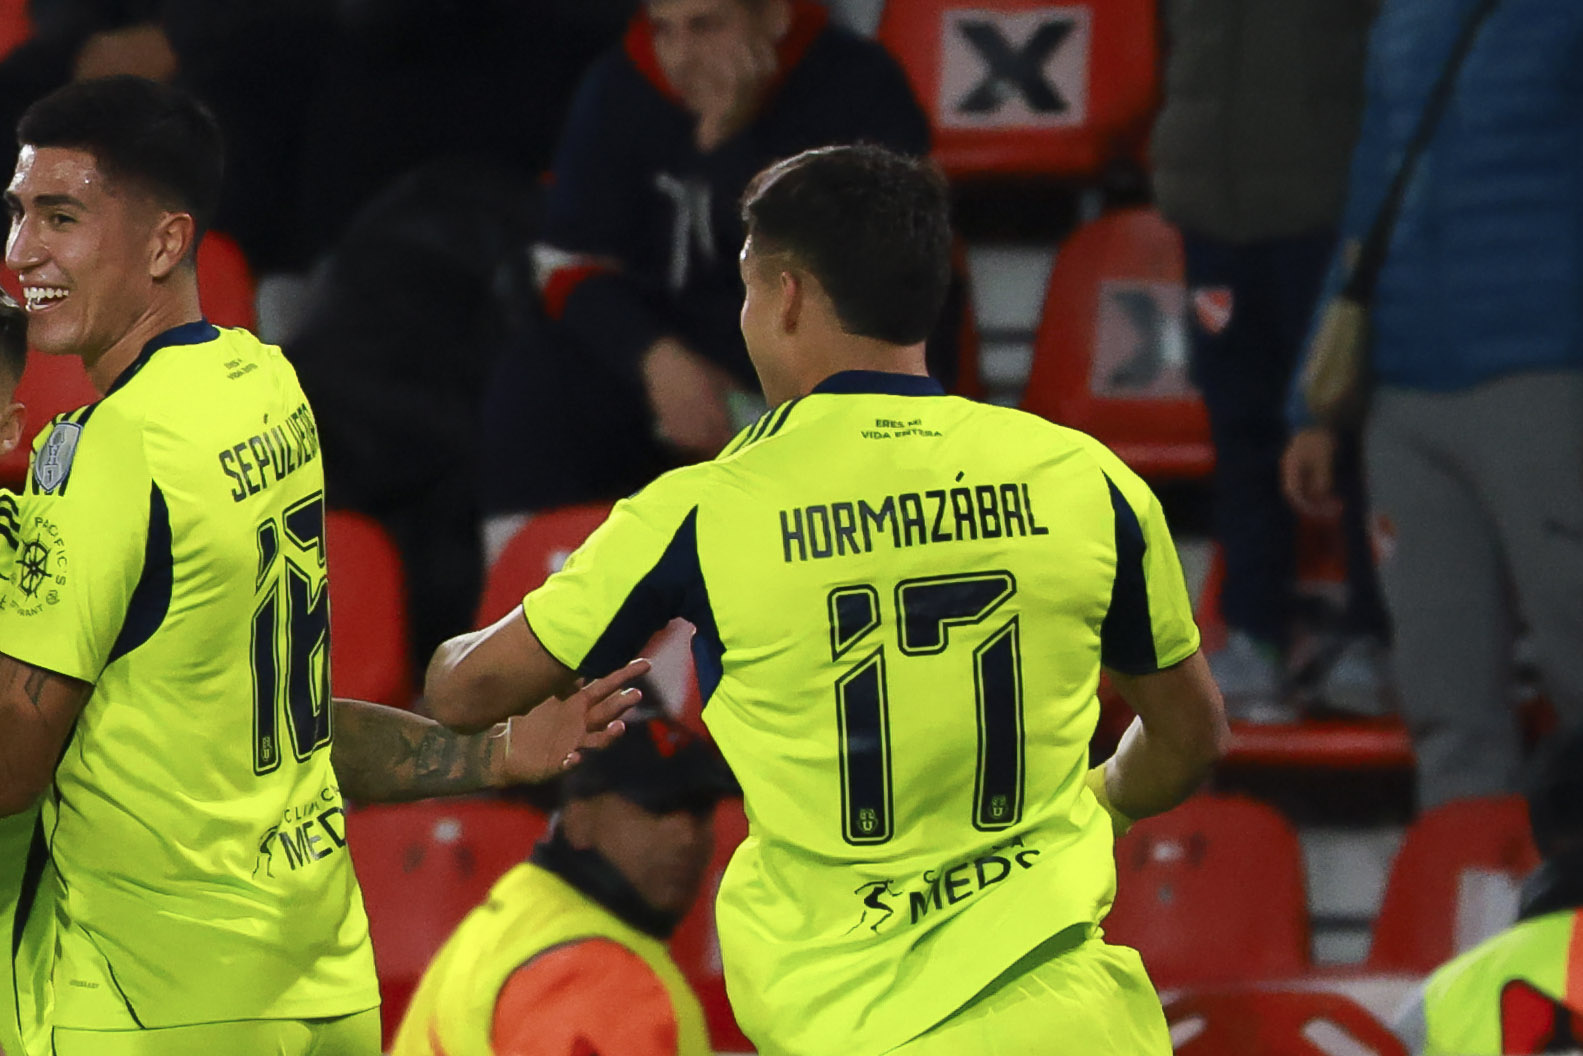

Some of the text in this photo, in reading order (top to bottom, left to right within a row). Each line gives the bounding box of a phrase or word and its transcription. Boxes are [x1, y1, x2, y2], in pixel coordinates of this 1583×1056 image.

[860, 430, 892, 440] VIDA
[779, 471, 1050, 563] HORMAZÁBAL
[827, 570, 1025, 846] 17
